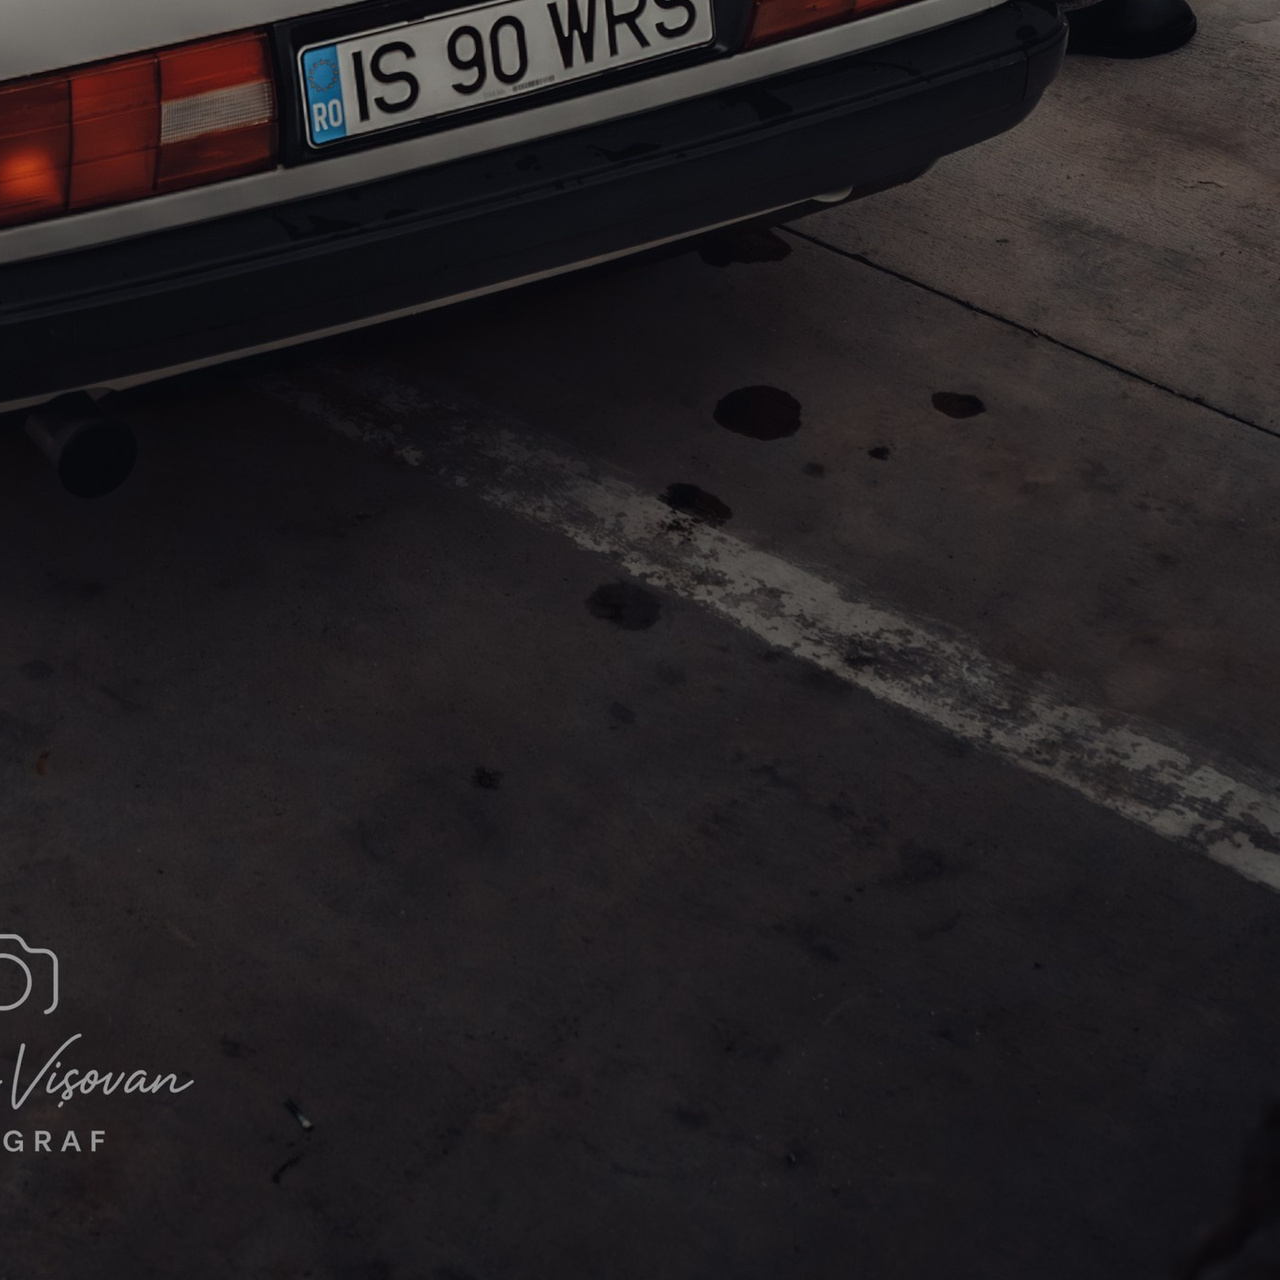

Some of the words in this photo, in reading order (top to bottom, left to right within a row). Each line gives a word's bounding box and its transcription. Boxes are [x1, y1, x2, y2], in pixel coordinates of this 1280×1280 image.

[351, 40, 420, 123] IS
[446, 15, 529, 96] 90
[312, 98, 344, 133] RO
